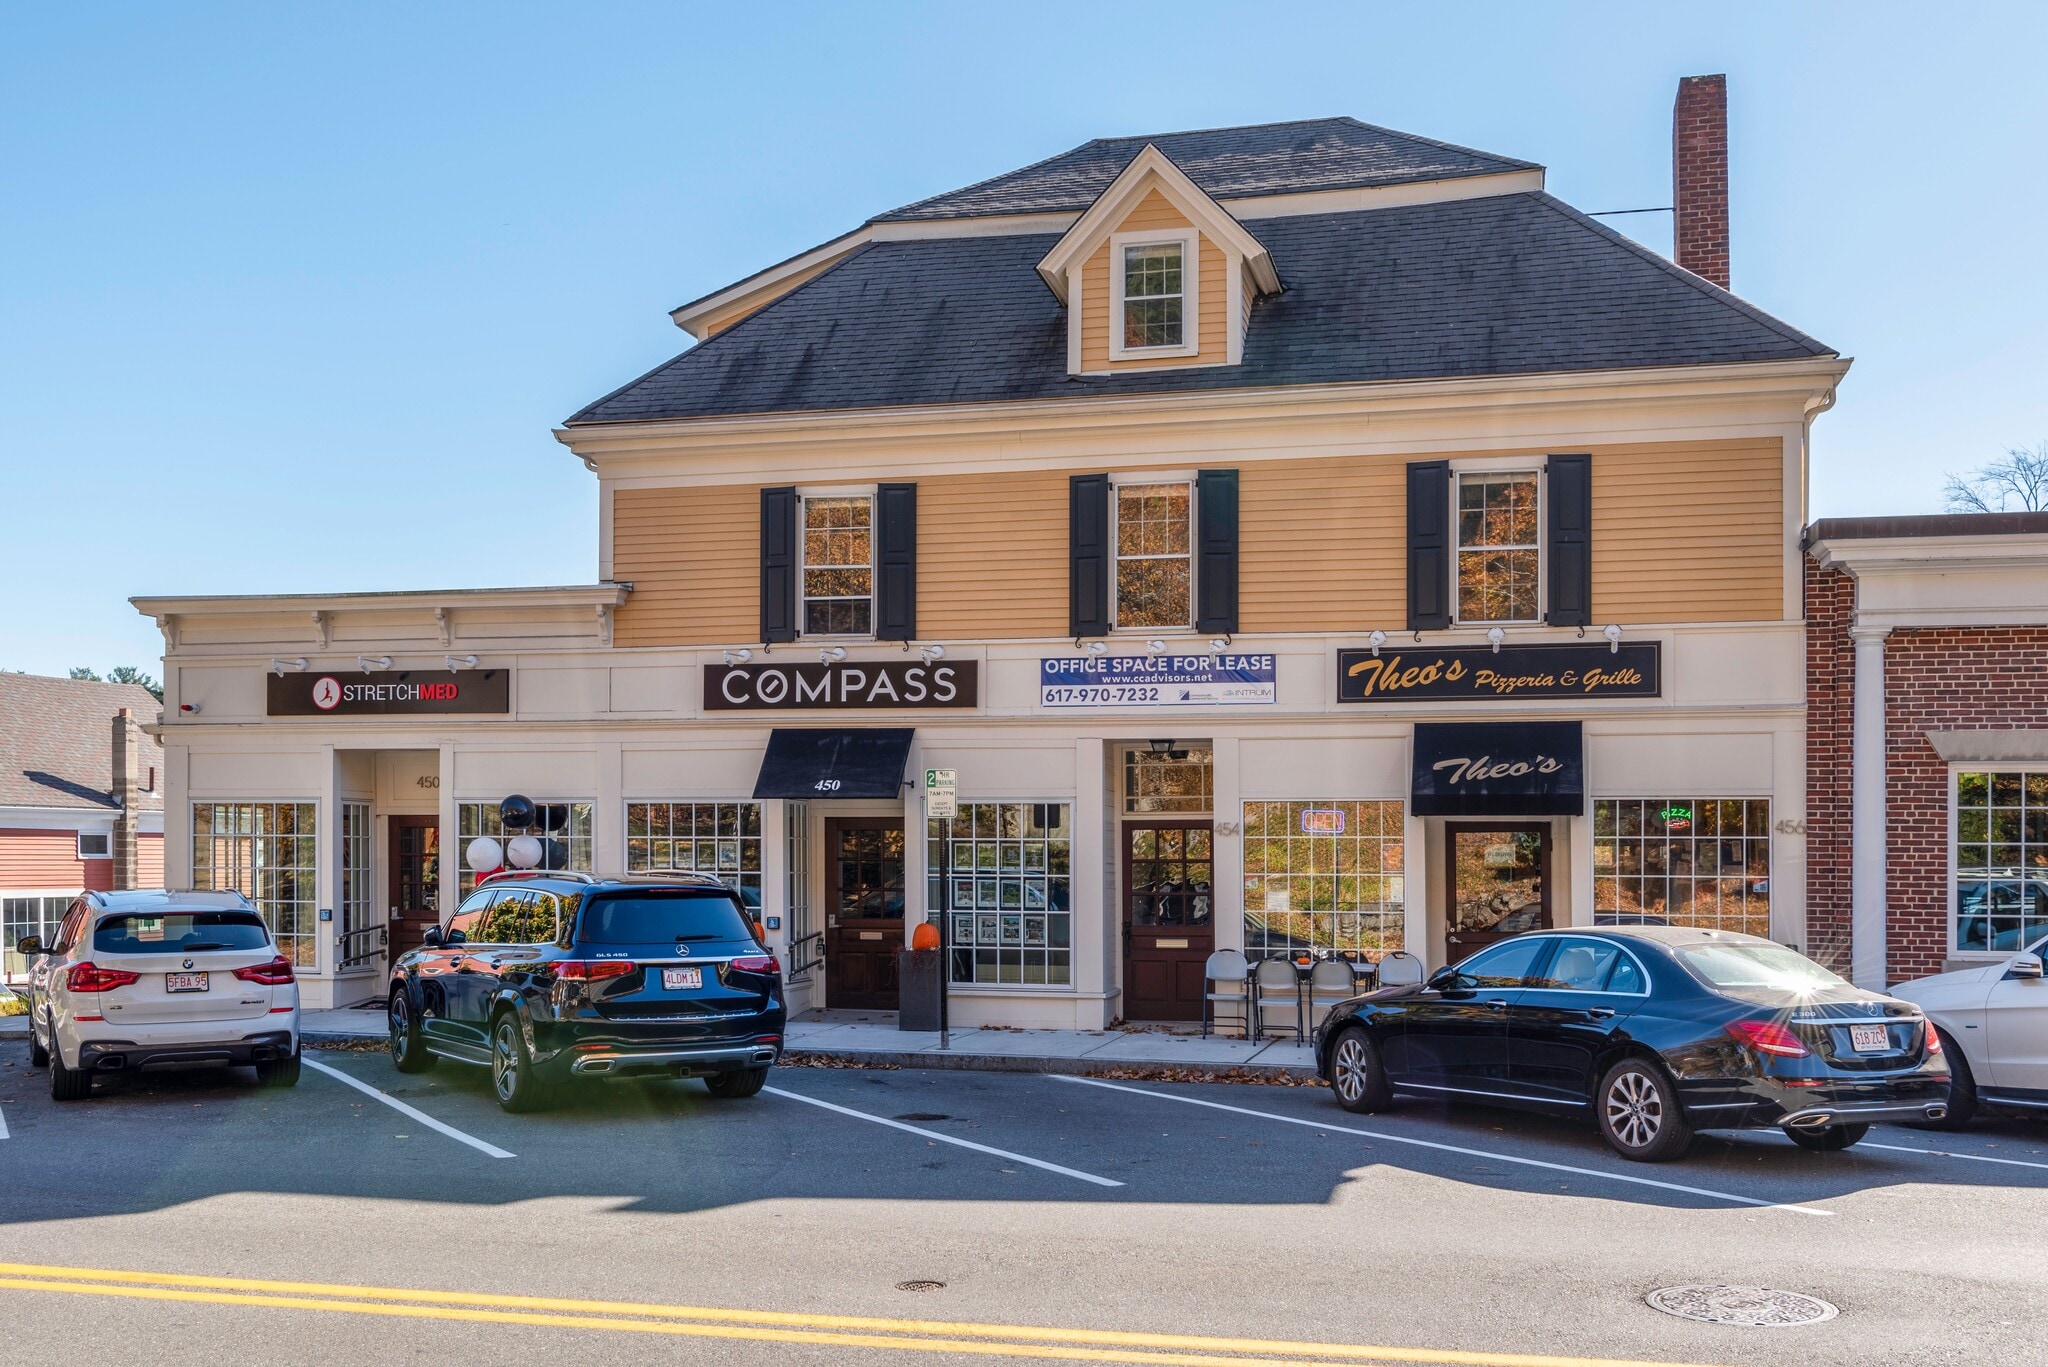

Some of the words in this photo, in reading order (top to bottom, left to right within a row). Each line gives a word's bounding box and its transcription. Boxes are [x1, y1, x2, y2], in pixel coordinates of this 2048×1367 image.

[1045, 658, 1107, 673] OFFICE
[1112, 658, 1168, 672] SPACE
[1173, 657, 1211, 671] FOR
[1215, 656, 1273, 670] LEASE
[1102, 673, 1213, 684] www.ccadvisors.net
[1348, 656, 1468, 697] Theo's
[1474, 669, 1555, 693] Pizzeria
[1559, 670, 1578, 685] &
[1582, 667, 1642, 692] Grille
[343, 683, 458, 701] STRETCHMED
[721, 667, 957, 704] COMPASS
[1045, 687, 1159, 703] 617-970-7232
[1432, 755, 1563, 785] Theo's
[416, 776, 440, 788] 450
[814, 779, 841, 791] 450
[928, 773, 935, 784] 2
[1304, 813, 1342, 829] OPEN
[1660, 808, 1692, 820] PIZZA
[1214, 822, 1240, 837] 454
[1775, 820, 1806, 834] 456
[168, 977, 192, 987] 5FBA
[195, 976, 207, 987] 95
[666, 973, 688, 984] 4LDM
[690, 973, 701, 984] 11
[1855, 1031, 1870, 1045] 618
[1871, 1031, 1886, 1044] ZC9
